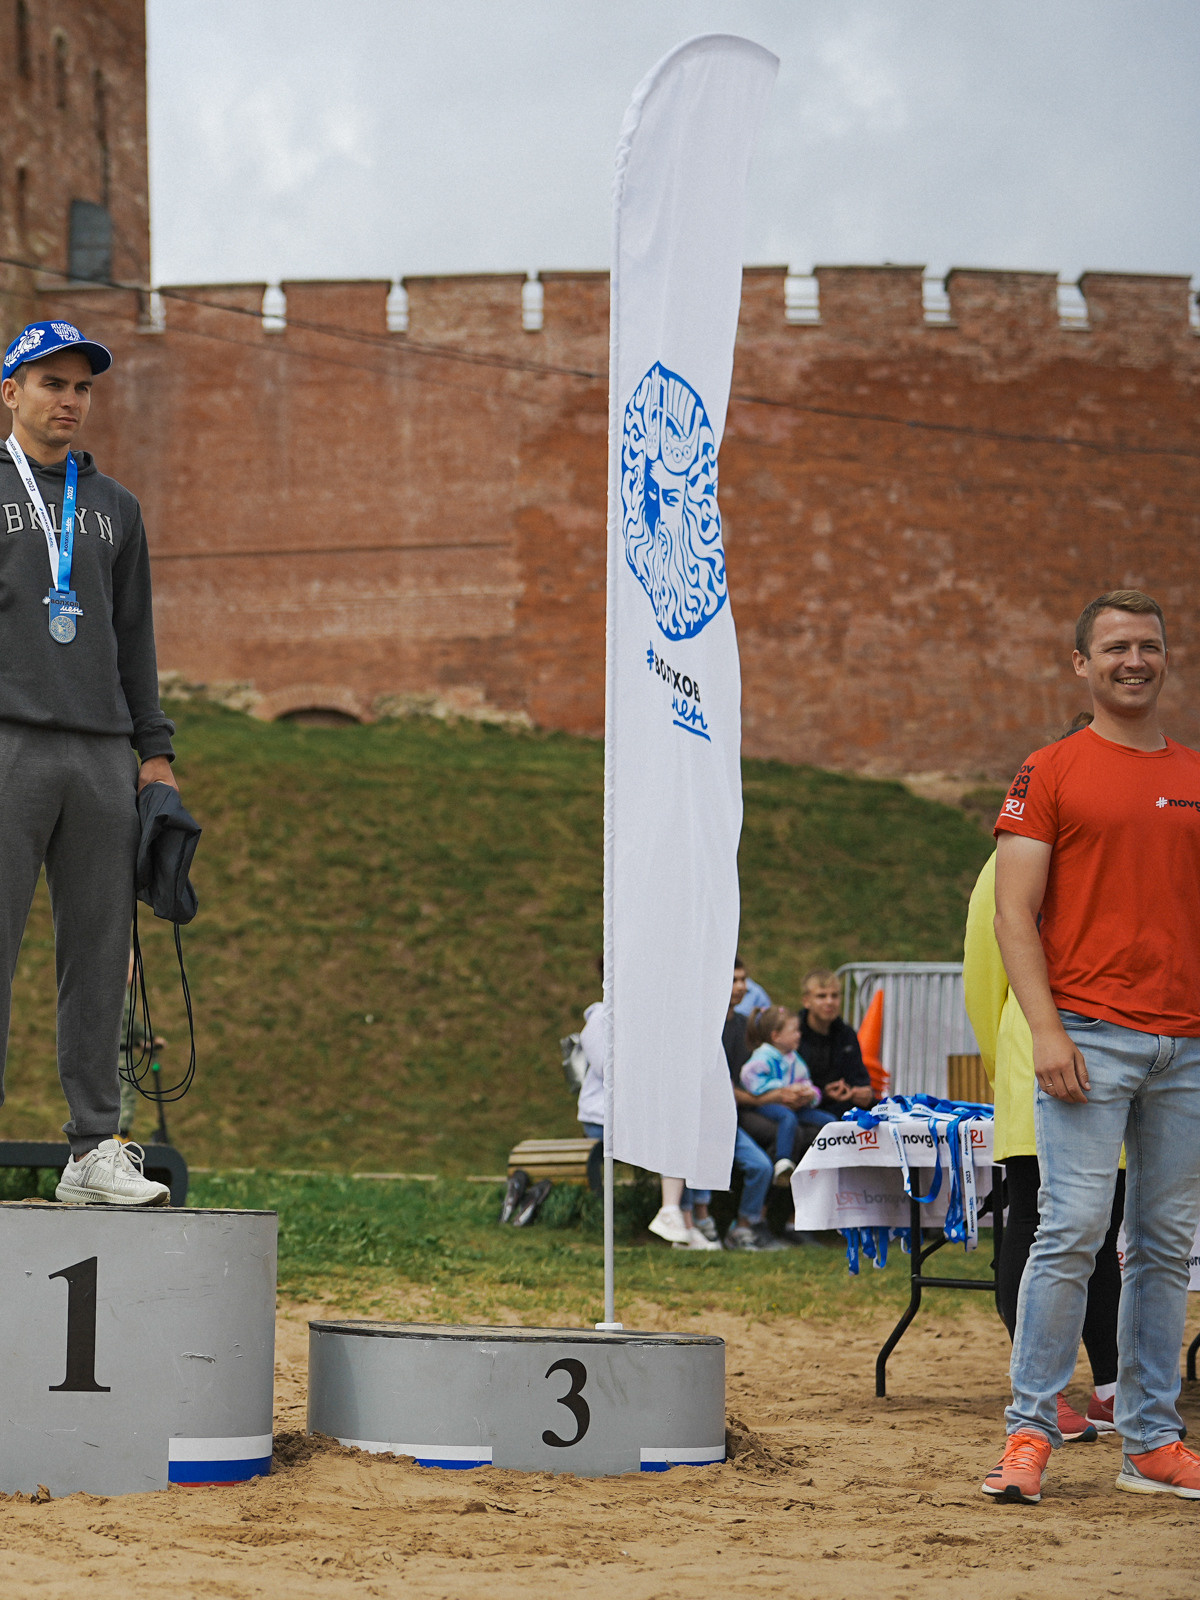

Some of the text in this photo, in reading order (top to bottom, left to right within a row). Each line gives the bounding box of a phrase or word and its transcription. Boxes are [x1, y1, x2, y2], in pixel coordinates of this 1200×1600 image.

[25, 477, 36, 492] 2023
[66, 486, 74, 500] 2023
[2, 502, 114, 546] BKLYN
[48, 1256, 111, 1392] 1
[542, 1358, 590, 1447] 3
